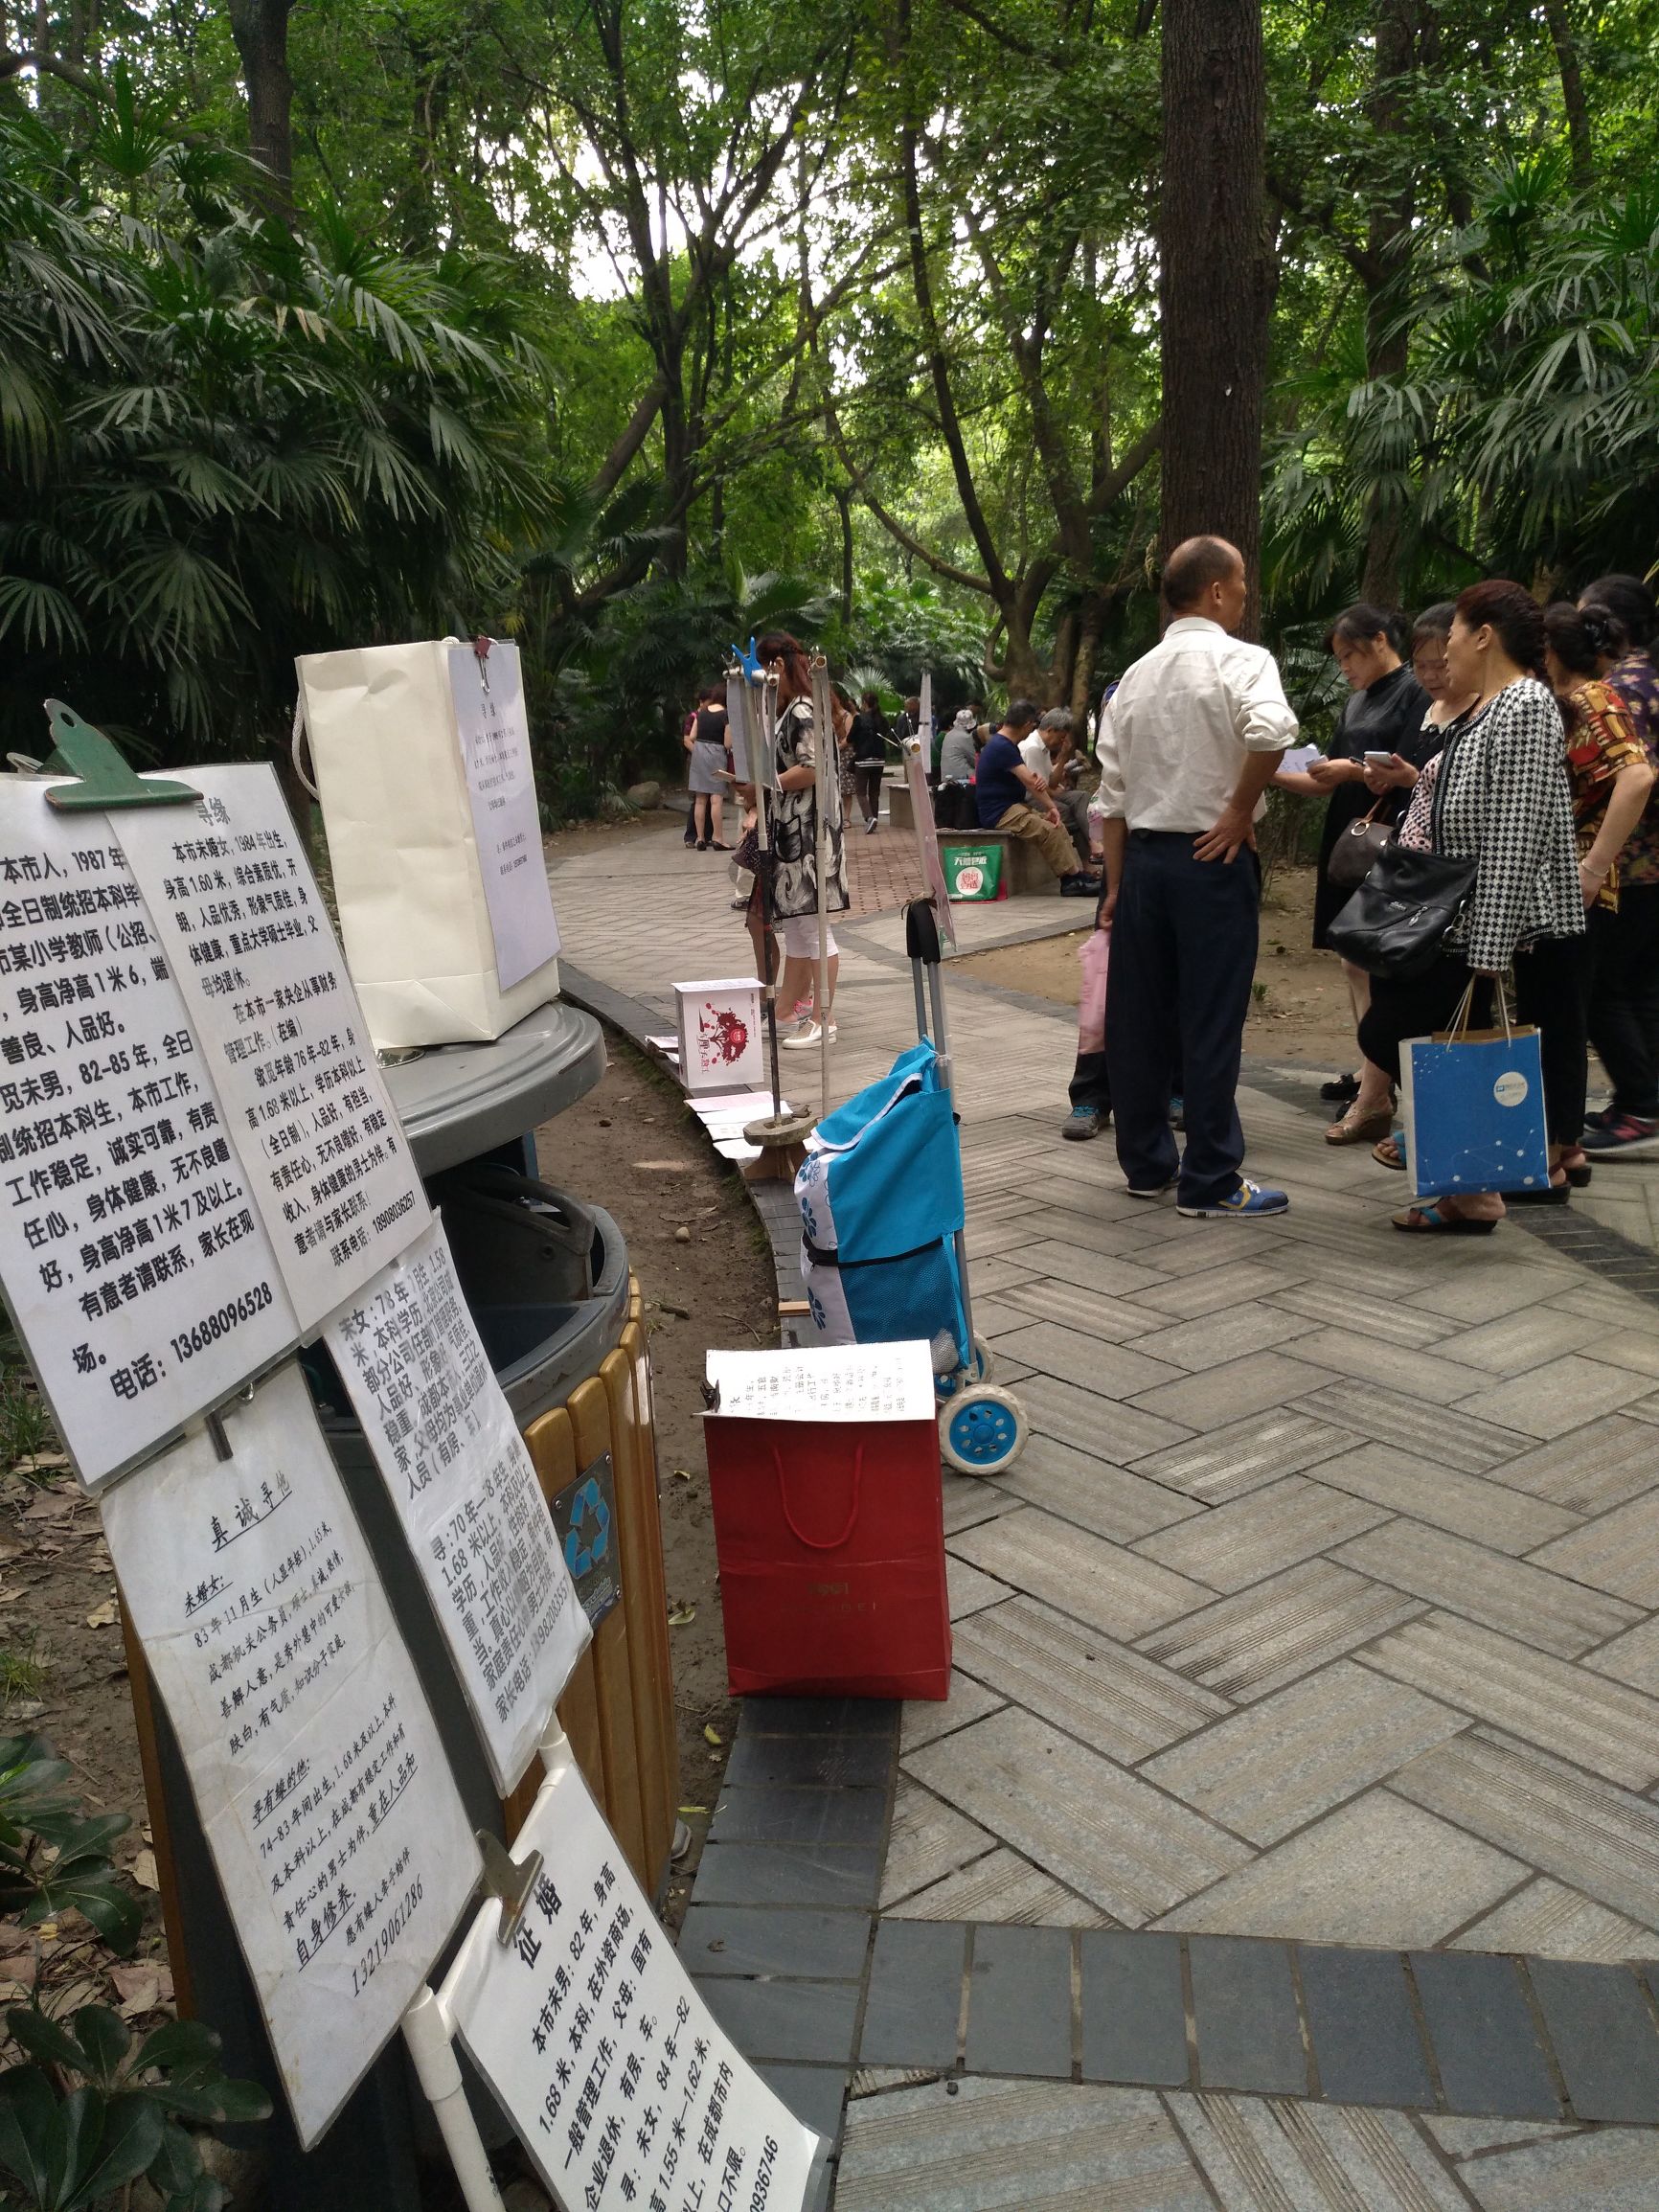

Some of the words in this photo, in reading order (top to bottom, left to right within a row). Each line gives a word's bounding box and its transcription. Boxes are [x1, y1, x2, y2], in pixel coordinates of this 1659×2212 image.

[0, 882, 141, 932] 全日制统招本科毕
[163, 858, 297, 901] 身高1.60米，综合素质优，开
[175, 886, 308, 933] 朗，人品优秀，形象气质佳，身
[189, 915, 319, 967] 体健康，重点大学硕士毕业，父
[201, 968, 251, 999] 母均退休。
[233, 971, 338, 1024] 在本市一家央企从事财务
[0, 1011, 125, 1065] 善良、人品好。
[245, 1056, 366, 1129] 高1.68米以上，学历本科以上
[5, 1102, 219, 1207] 工作稳定，诚实可靠，有责
[269, 1108, 387, 1193] 有责任心，无不良嗜好，有稳定
[283, 1136, 397, 1223] 收入，身体健康的男士为伴。有
[23, 1137, 231, 1249] 任心，身体健康，无不良嗜
[39, 1178, 243, 1293] 好，身高净高1米7及以上。
[79, 1208, 255, 1321] 有意者请联系，家长在现
[72, 1342, 107, 1374] 场。
[211, 1470, 291, 1551] 真诚寻他
